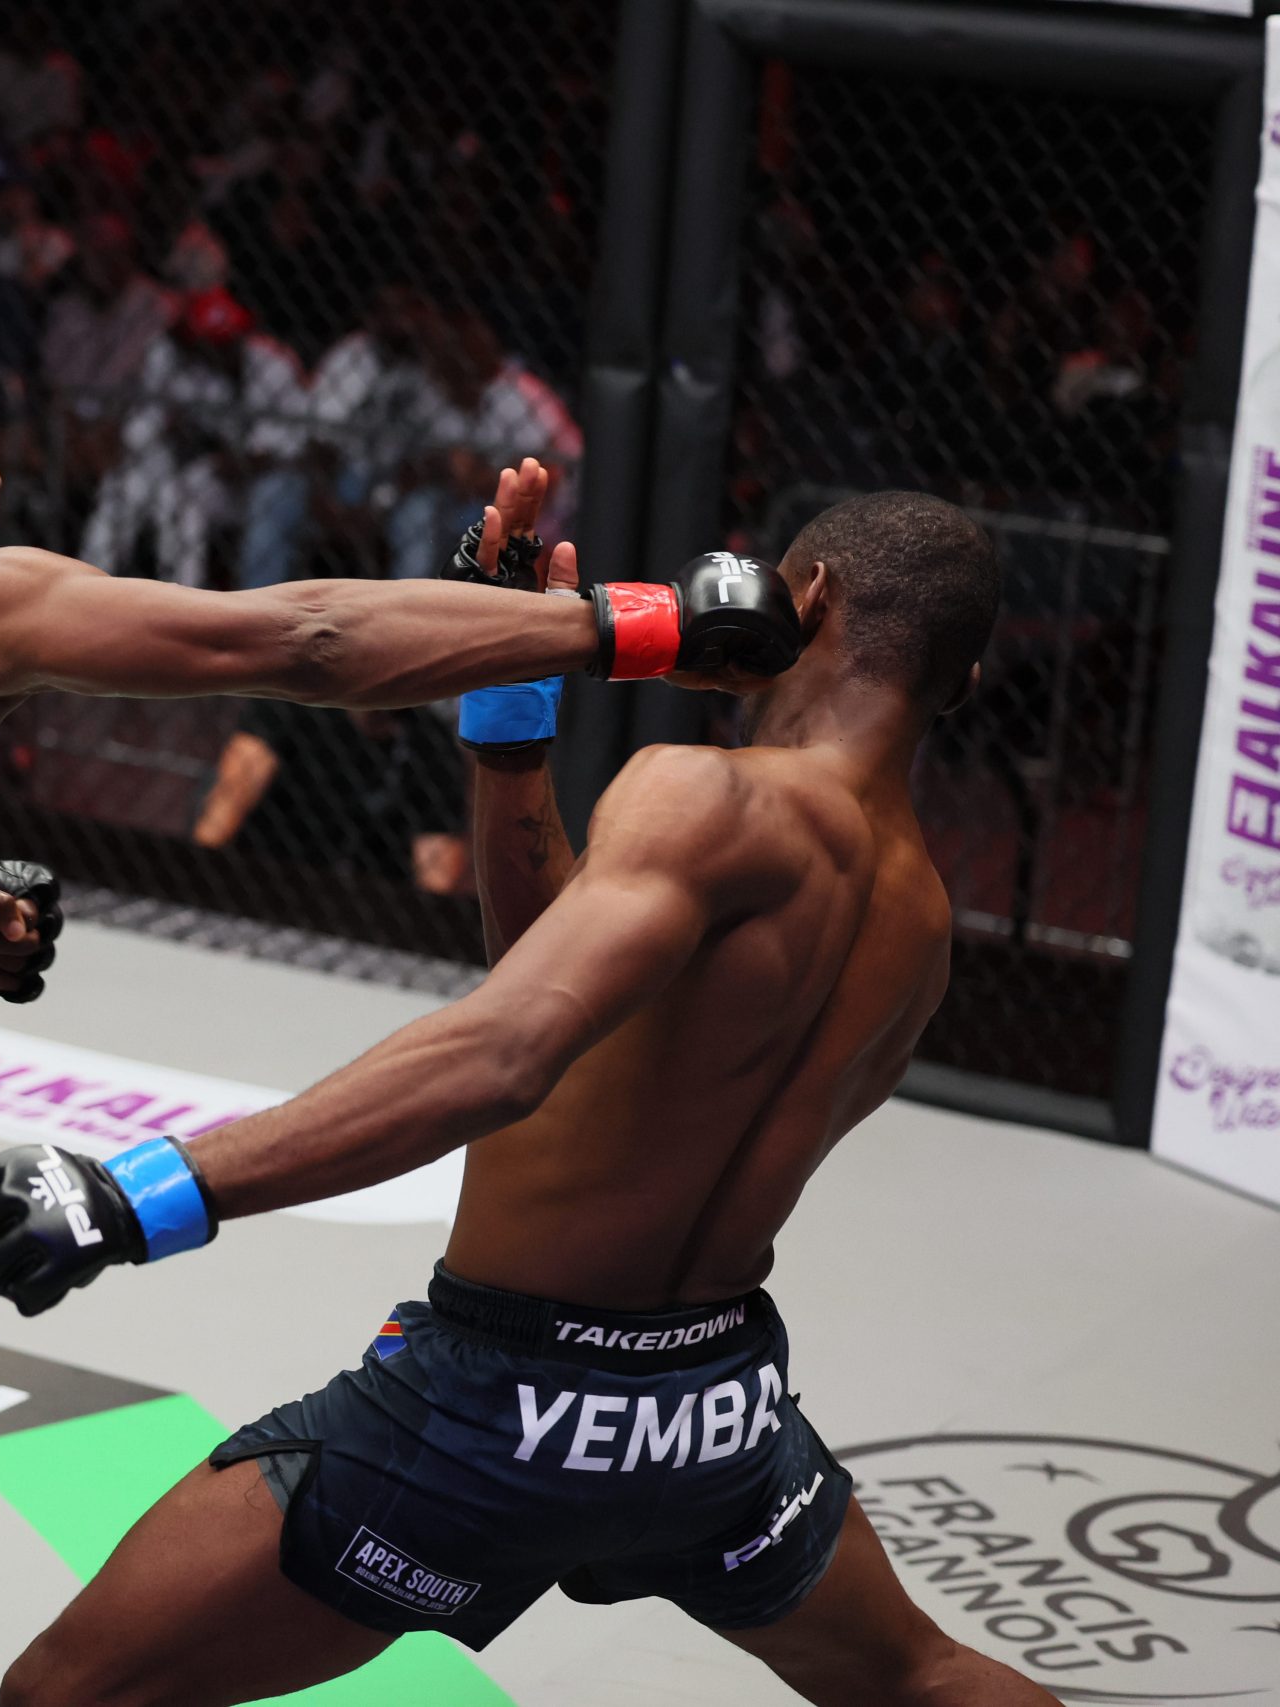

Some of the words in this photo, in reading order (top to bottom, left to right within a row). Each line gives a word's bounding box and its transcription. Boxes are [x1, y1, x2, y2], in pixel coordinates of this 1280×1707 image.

[37, 1144, 103, 1247] PFL
[555, 1303, 745, 1351] TAKEDOWN
[513, 1362, 782, 1472] YEMBA
[355, 1540, 410, 1583] APEX
[406, 1568, 468, 1604] SOUTH
[877, 1476, 1189, 1663] FRANCIS
